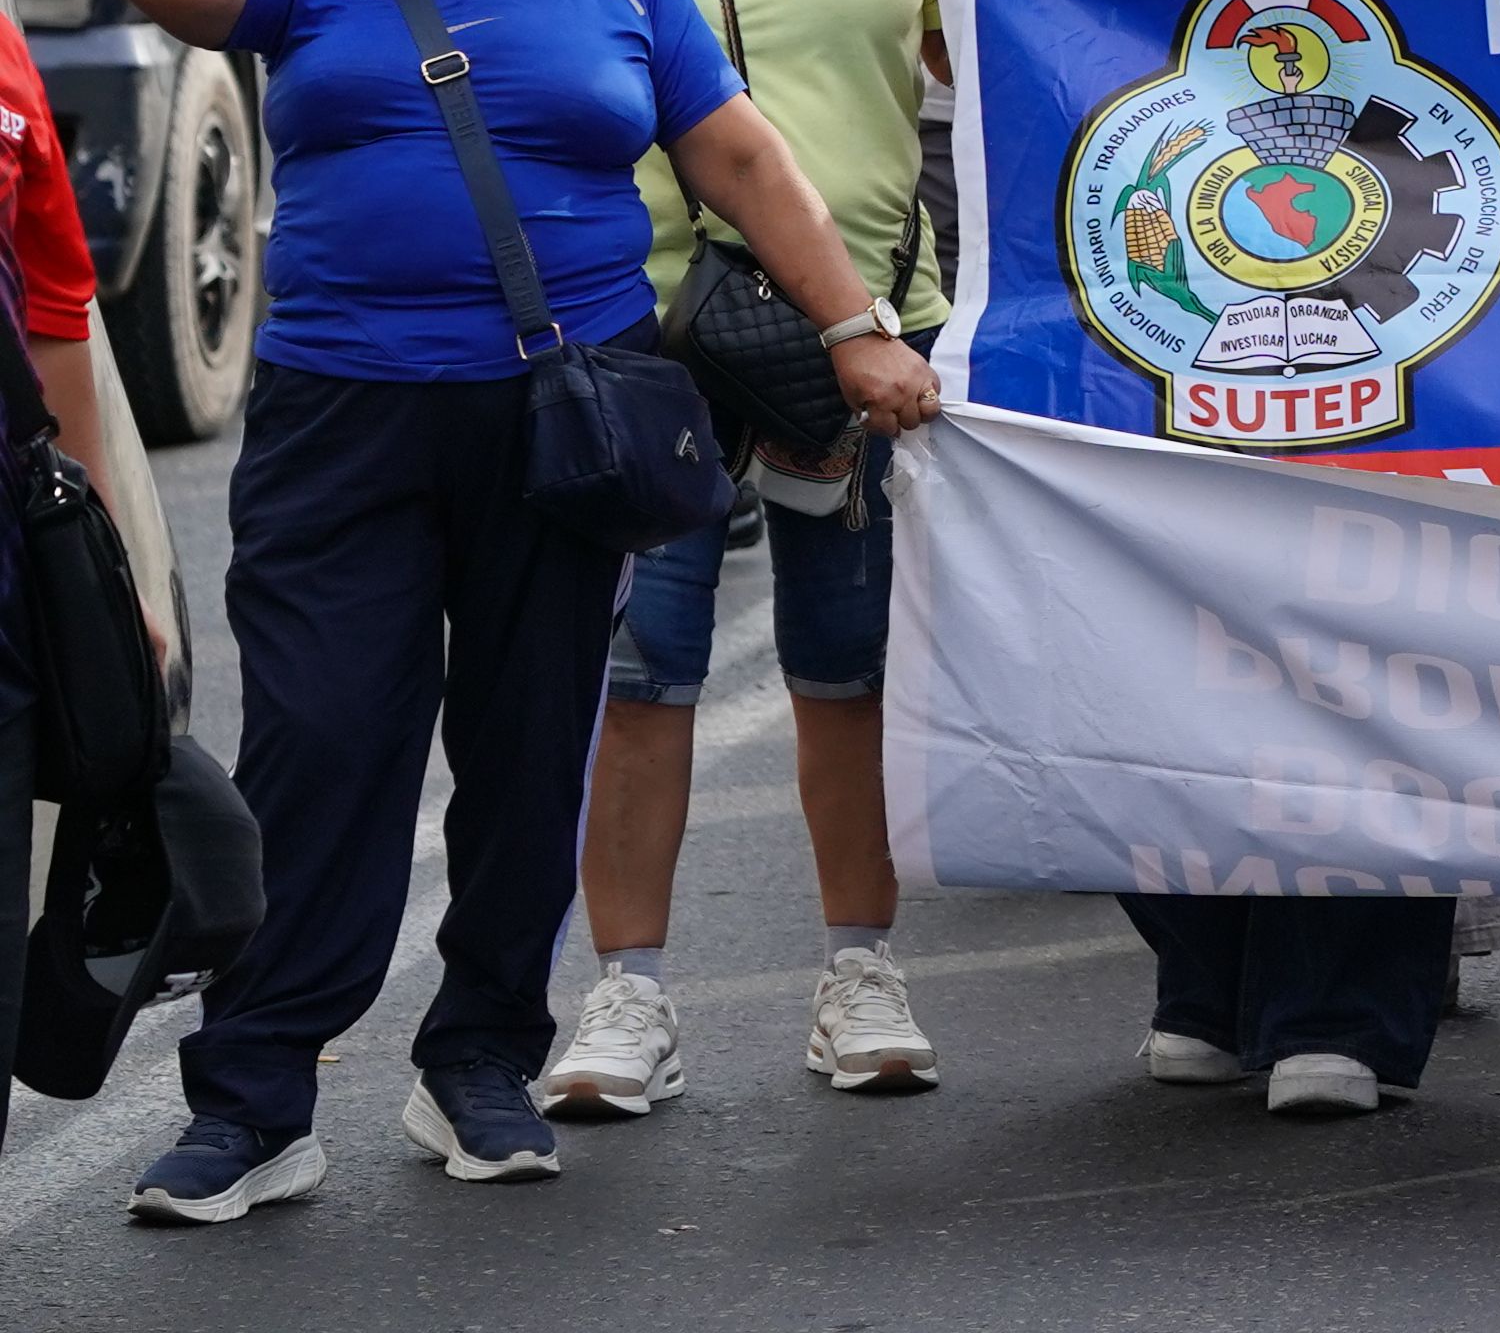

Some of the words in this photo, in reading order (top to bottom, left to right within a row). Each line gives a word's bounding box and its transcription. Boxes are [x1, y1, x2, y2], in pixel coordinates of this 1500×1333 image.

[1428, 101, 1454, 126] EN
[1094, 88, 1197, 173] TRABAJADORES
[1454, 128, 1476, 151] LA
[1087, 183, 1103, 206] DE
[1196, 164, 1234, 212] UNIDAD
[1344, 165, 1382, 216] SINDICAL
[1471, 155, 1500, 238] EDUCACIÓN
[1196, 216, 1216, 238] LA
[1085, 216, 1115, 288] UNITARIO
[1212, 239, 1238, 268] POR
[1318, 218, 1378, 274] CLASISTA
[1457, 246, 1485, 276] DEL
[1226, 304, 1281, 328] ESTUDIAR
[1289, 304, 1350, 324] ORGANIZAR
[1419, 282, 1461, 323] PERÚ
[1109, 290, 1186, 355] SINDICATO
[1219, 334, 1286, 354] INVESTIGAR
[1293, 332, 1338, 349] LUCHAR
[1188, 377, 1382, 434] SUTEP
